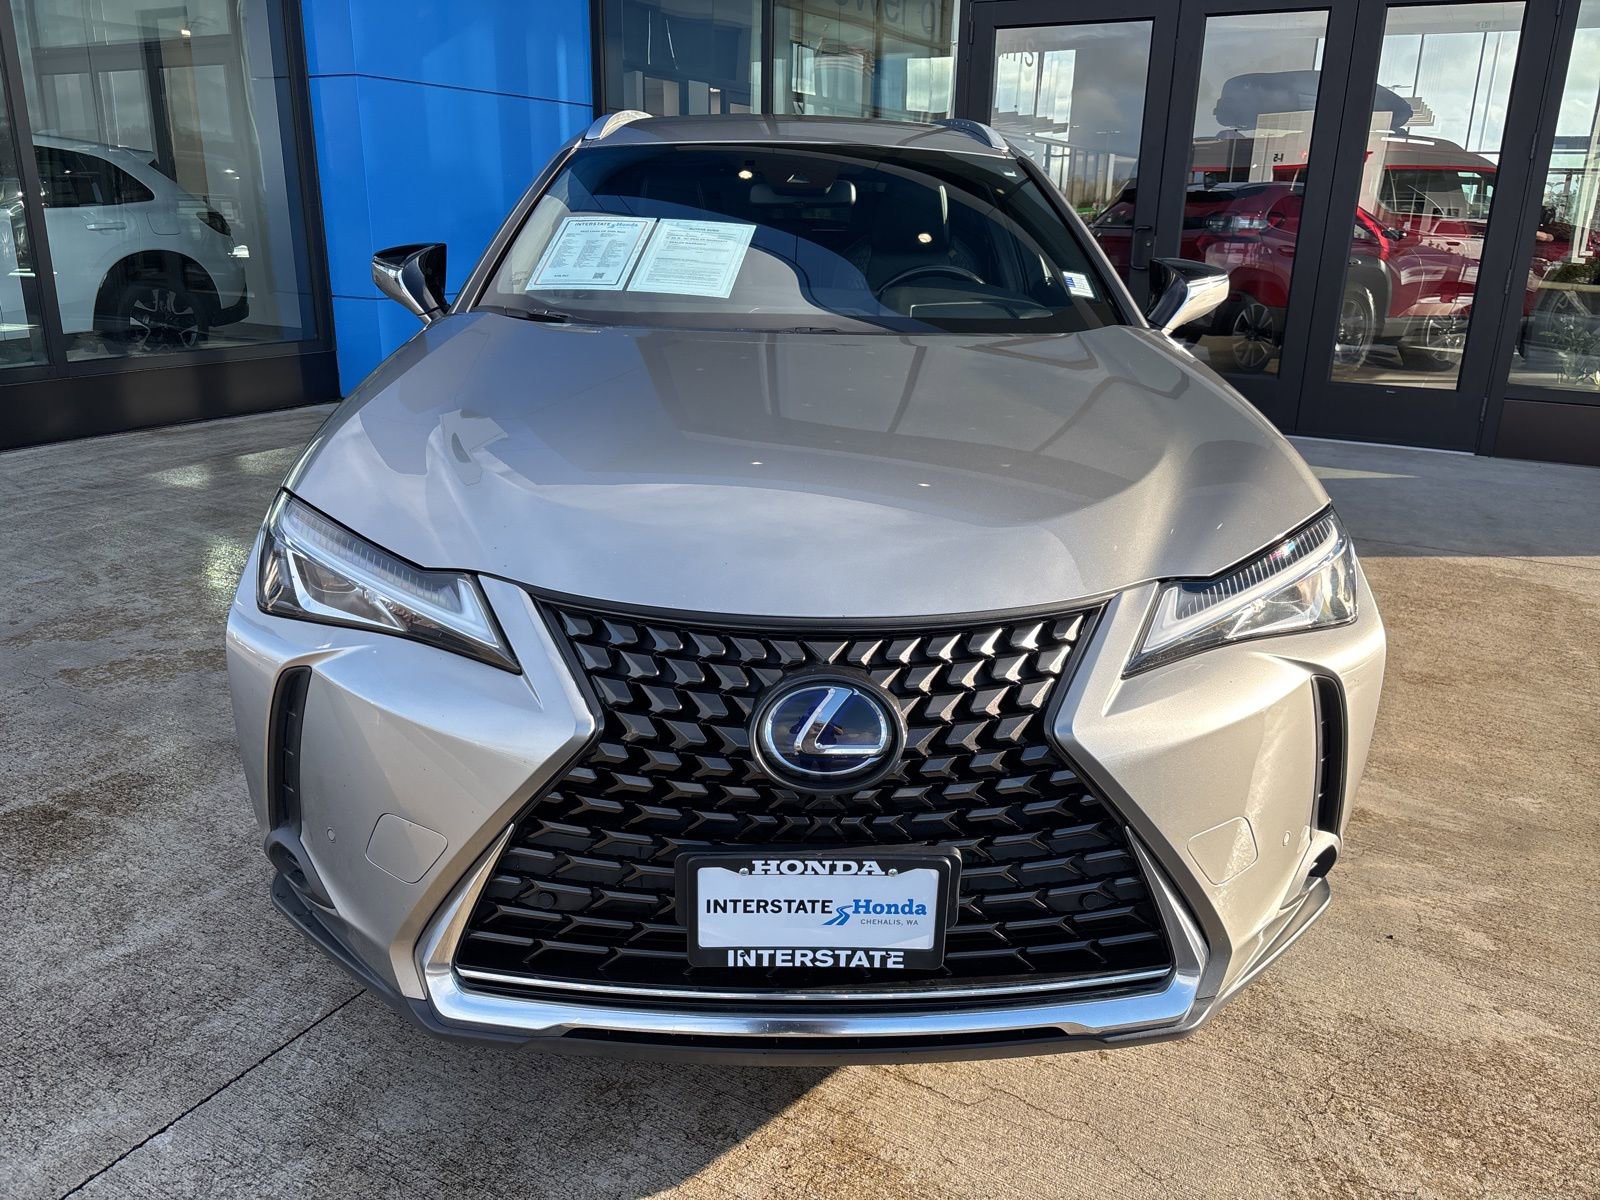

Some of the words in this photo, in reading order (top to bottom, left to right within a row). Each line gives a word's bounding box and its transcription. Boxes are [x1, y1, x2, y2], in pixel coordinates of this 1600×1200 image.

[751, 859, 885, 875] HONDA
[706, 898, 833, 914] INTERSTATE
[851, 898, 927, 915] Honda
[860, 918, 904, 926] CHEHALIS,
[727, 949, 905, 969] INTERSTATE
